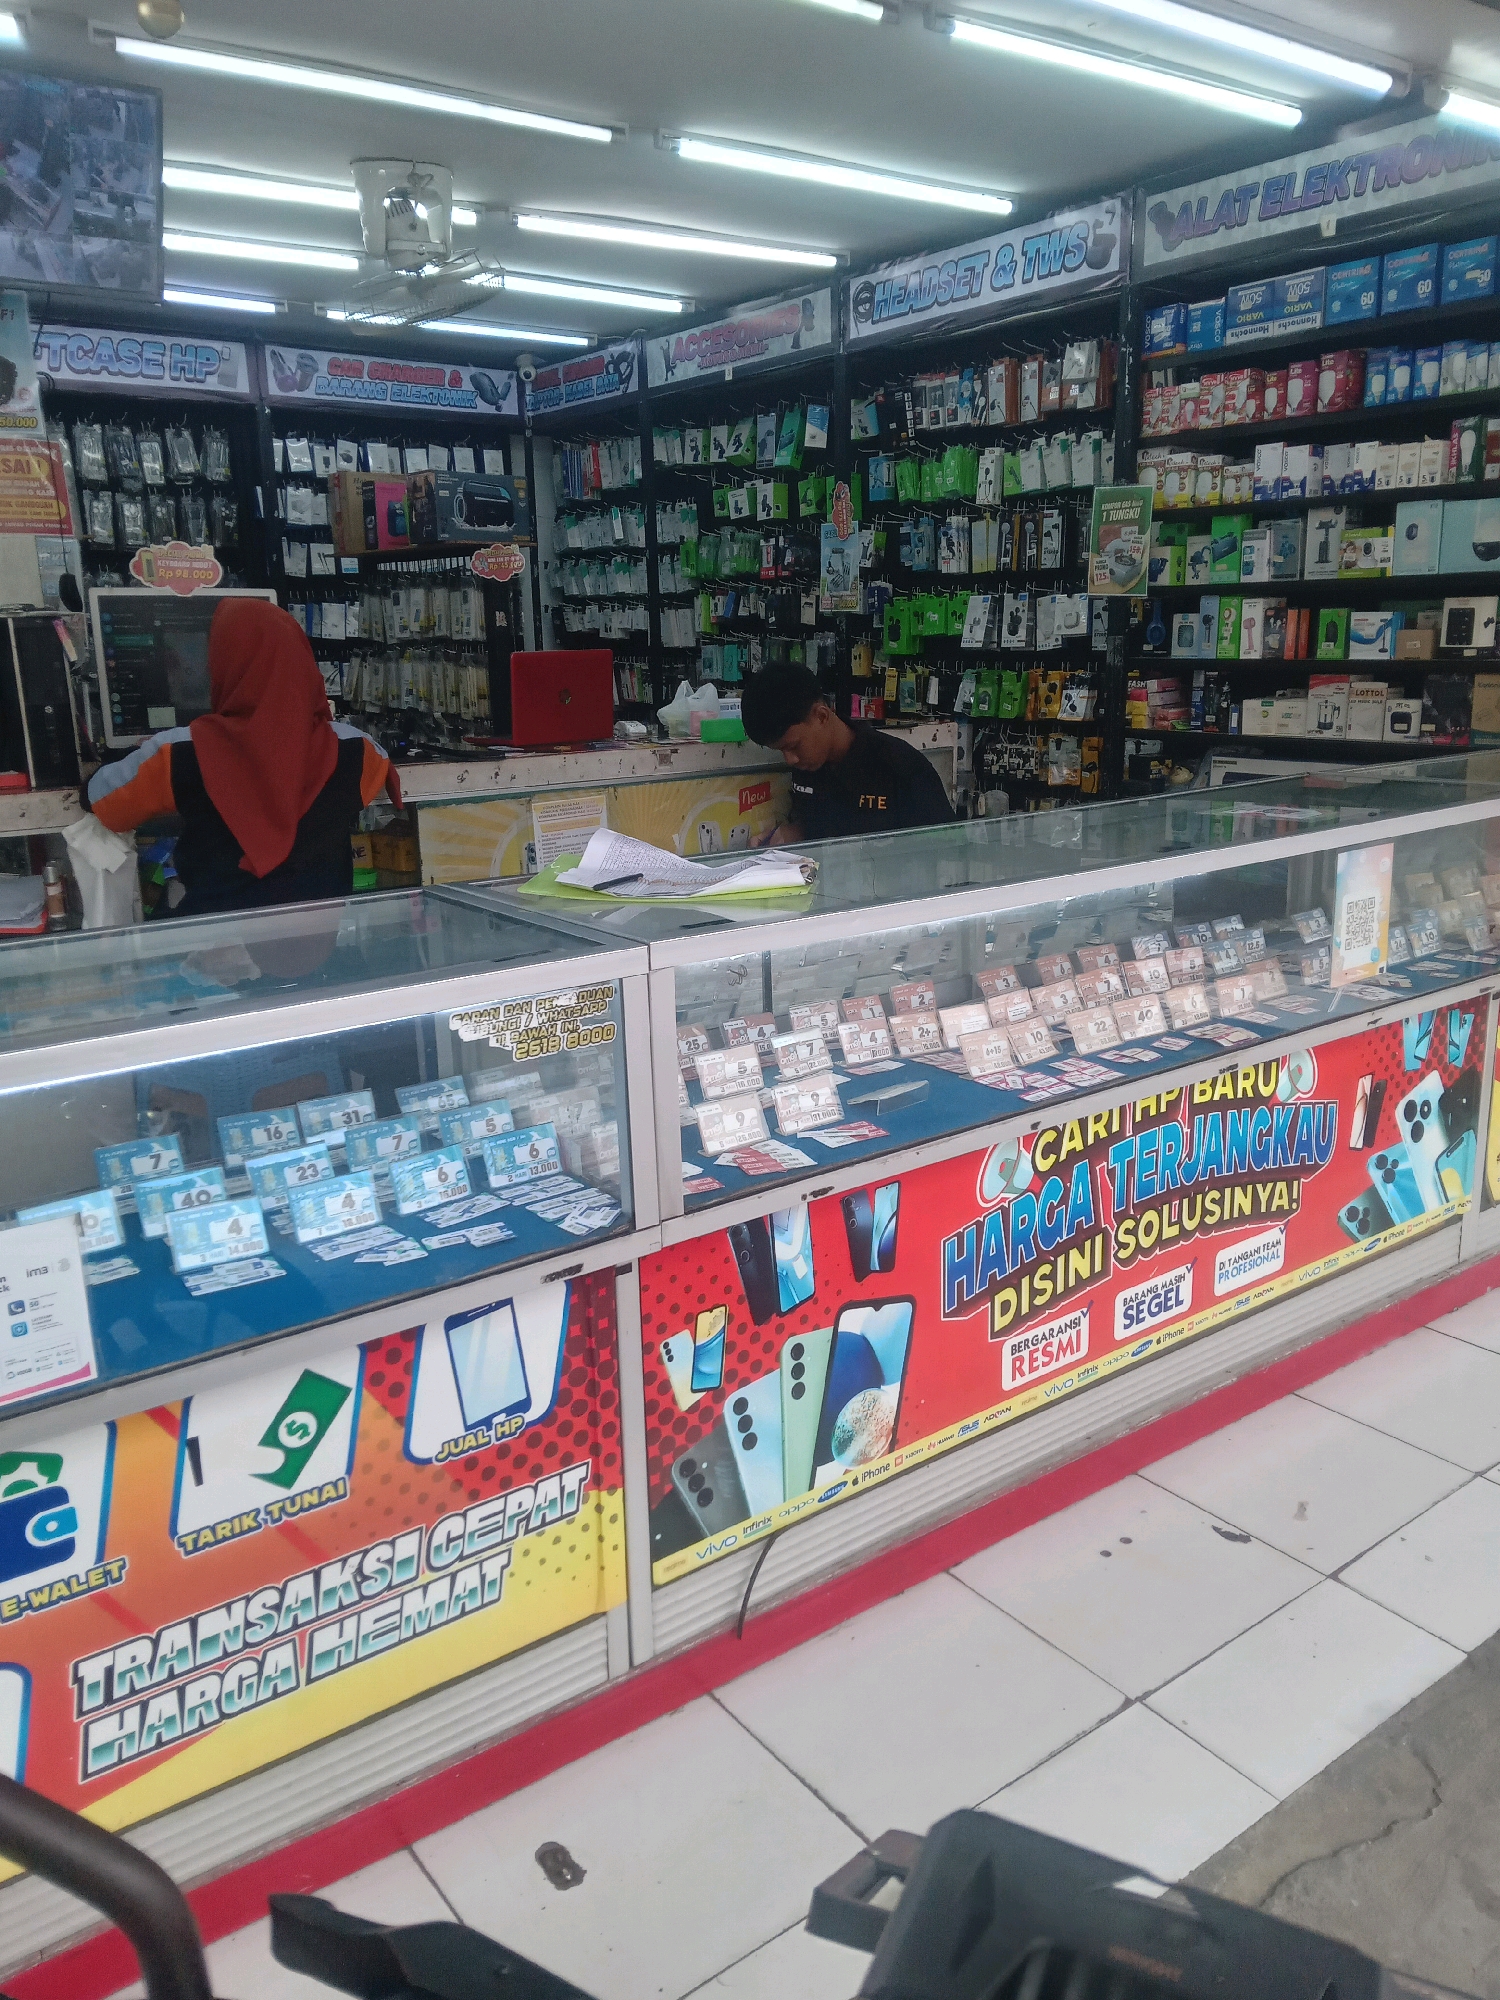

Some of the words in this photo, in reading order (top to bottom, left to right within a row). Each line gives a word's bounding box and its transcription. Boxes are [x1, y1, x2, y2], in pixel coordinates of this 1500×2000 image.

[1170, 182, 1259, 241] ALAT
[872, 250, 990, 324] HEADSET
[990, 243, 1016, 293] &
[1021, 220, 1090, 284] TWS
[1417, 279, 1433, 295] 60
[1284, 301, 1313, 314] VARIO
[1360, 291, 1375, 306] 60
[1236, 311, 1265, 324] VARIO
[1144, 315, 1152, 349] VOSCO
[168, 343, 221, 384] HP
[327, 357, 364, 379] CAR
[367, 361, 446, 388] CHARGER
[448, 369, 463, 388] &
[315, 376, 388, 401] BARANG
[1102, 512, 1107, 522] 1
[1109, 506, 1141, 521] TUNGKU
[158, 568, 173, 580] Rp
[741, 789, 767, 804] New
[1002, 977, 1011, 988] 3
[918, 993, 926, 1006] 2
[1060, 993, 1069, 1005] 3
[451, 1007, 501, 1026] SARAN
[503, 1001, 533, 1018] DAN
[536, 1001, 608, 1025] WHATSAPP
[756, 1026, 766, 1039] 4
[1030, 1030, 1044, 1043] 10
[1093, 1020, 1109, 1034] 22
[515, 1036, 562, 1061] 2618
[566, 1024, 616, 1049] 8000
[685, 1038, 700, 1052] 25
[869, 1031, 878, 1044] 4
[737, 1060, 748, 1075] 5
[811, 1091, 820, 1107] 9
[341, 1108, 362, 1127] 31
[485, 1117, 497, 1134] 5
[736, 1111, 746, 1127] 9
[1033, 1105, 1122, 1172] CARI
[1134, 1085, 1182, 1123] HP
[1193, 1061, 1280, 1104] BARU
[263, 1126, 284, 1143] 16
[392, 1134, 403, 1151] 7
[528, 1142, 540, 1160] 6
[150, 1153, 162, 1171] 7
[529, 1160, 558, 1177] 13.000
[295, 1163, 321, 1182] 23
[437, 1166, 449, 1183] 6
[507, 1174, 514, 1183] 2
[180, 1188, 212, 1209] 40
[943, 1160, 1095, 1313] HARGA
[1109, 1101, 1339, 1213] TERJANGKAU
[227, 1217, 244, 1237] 4
[992, 1231, 1105, 1333] DISINI
[1116, 1179, 1300, 1260] SOLUSINYA!
[1219, 1260, 1226, 1272] DI
[1228, 1246, 1262, 1269] TANGANI
[1262, 1237, 1282, 1253] TEAM
[26, 1265, 49, 1279] im3
[1218, 1248, 1281, 1284] PROFESIONAL
[1123, 1284, 1159, 1307] BARANG
[1161, 1272, 1186, 1291] MASIH
[1123, 1285, 1185, 1330] SEGEL
[1010, 1314, 1082, 1357] BERGARANSI
[1011, 1336, 1083, 1383] RESMI
[696, 1534, 738, 1560] vivo
[743, 1515, 773, 1536] Infinix
[778, 1497, 816, 1519] oppo
[861, 1461, 891, 1483] iPhone
[1044, 1377, 1075, 1399] vivo
[1077, 1363, 1100, 1380] Infinix
[1102, 1350, 1130, 1368] oppo
[1162, 1326, 1186, 1343] iPhone
[1298, 1266, 1322, 1283] vivo
[1387, 1228, 1406, 1242] iPhone
[435, 1429, 491, 1464] JUAL
[494, 1413, 526, 1443] HP
[179, 1509, 261, 1555] TARIK
[264, 1476, 349, 1524] TUNAI
[0, 1558, 127, 1621] E-WALET
[72, 1526, 426, 1719] TRANSAKSI
[427, 1462, 590, 1577] CEPAT
[79, 1633, 299, 1781] HARGA
[306, 1546, 513, 1688] HEMAT
